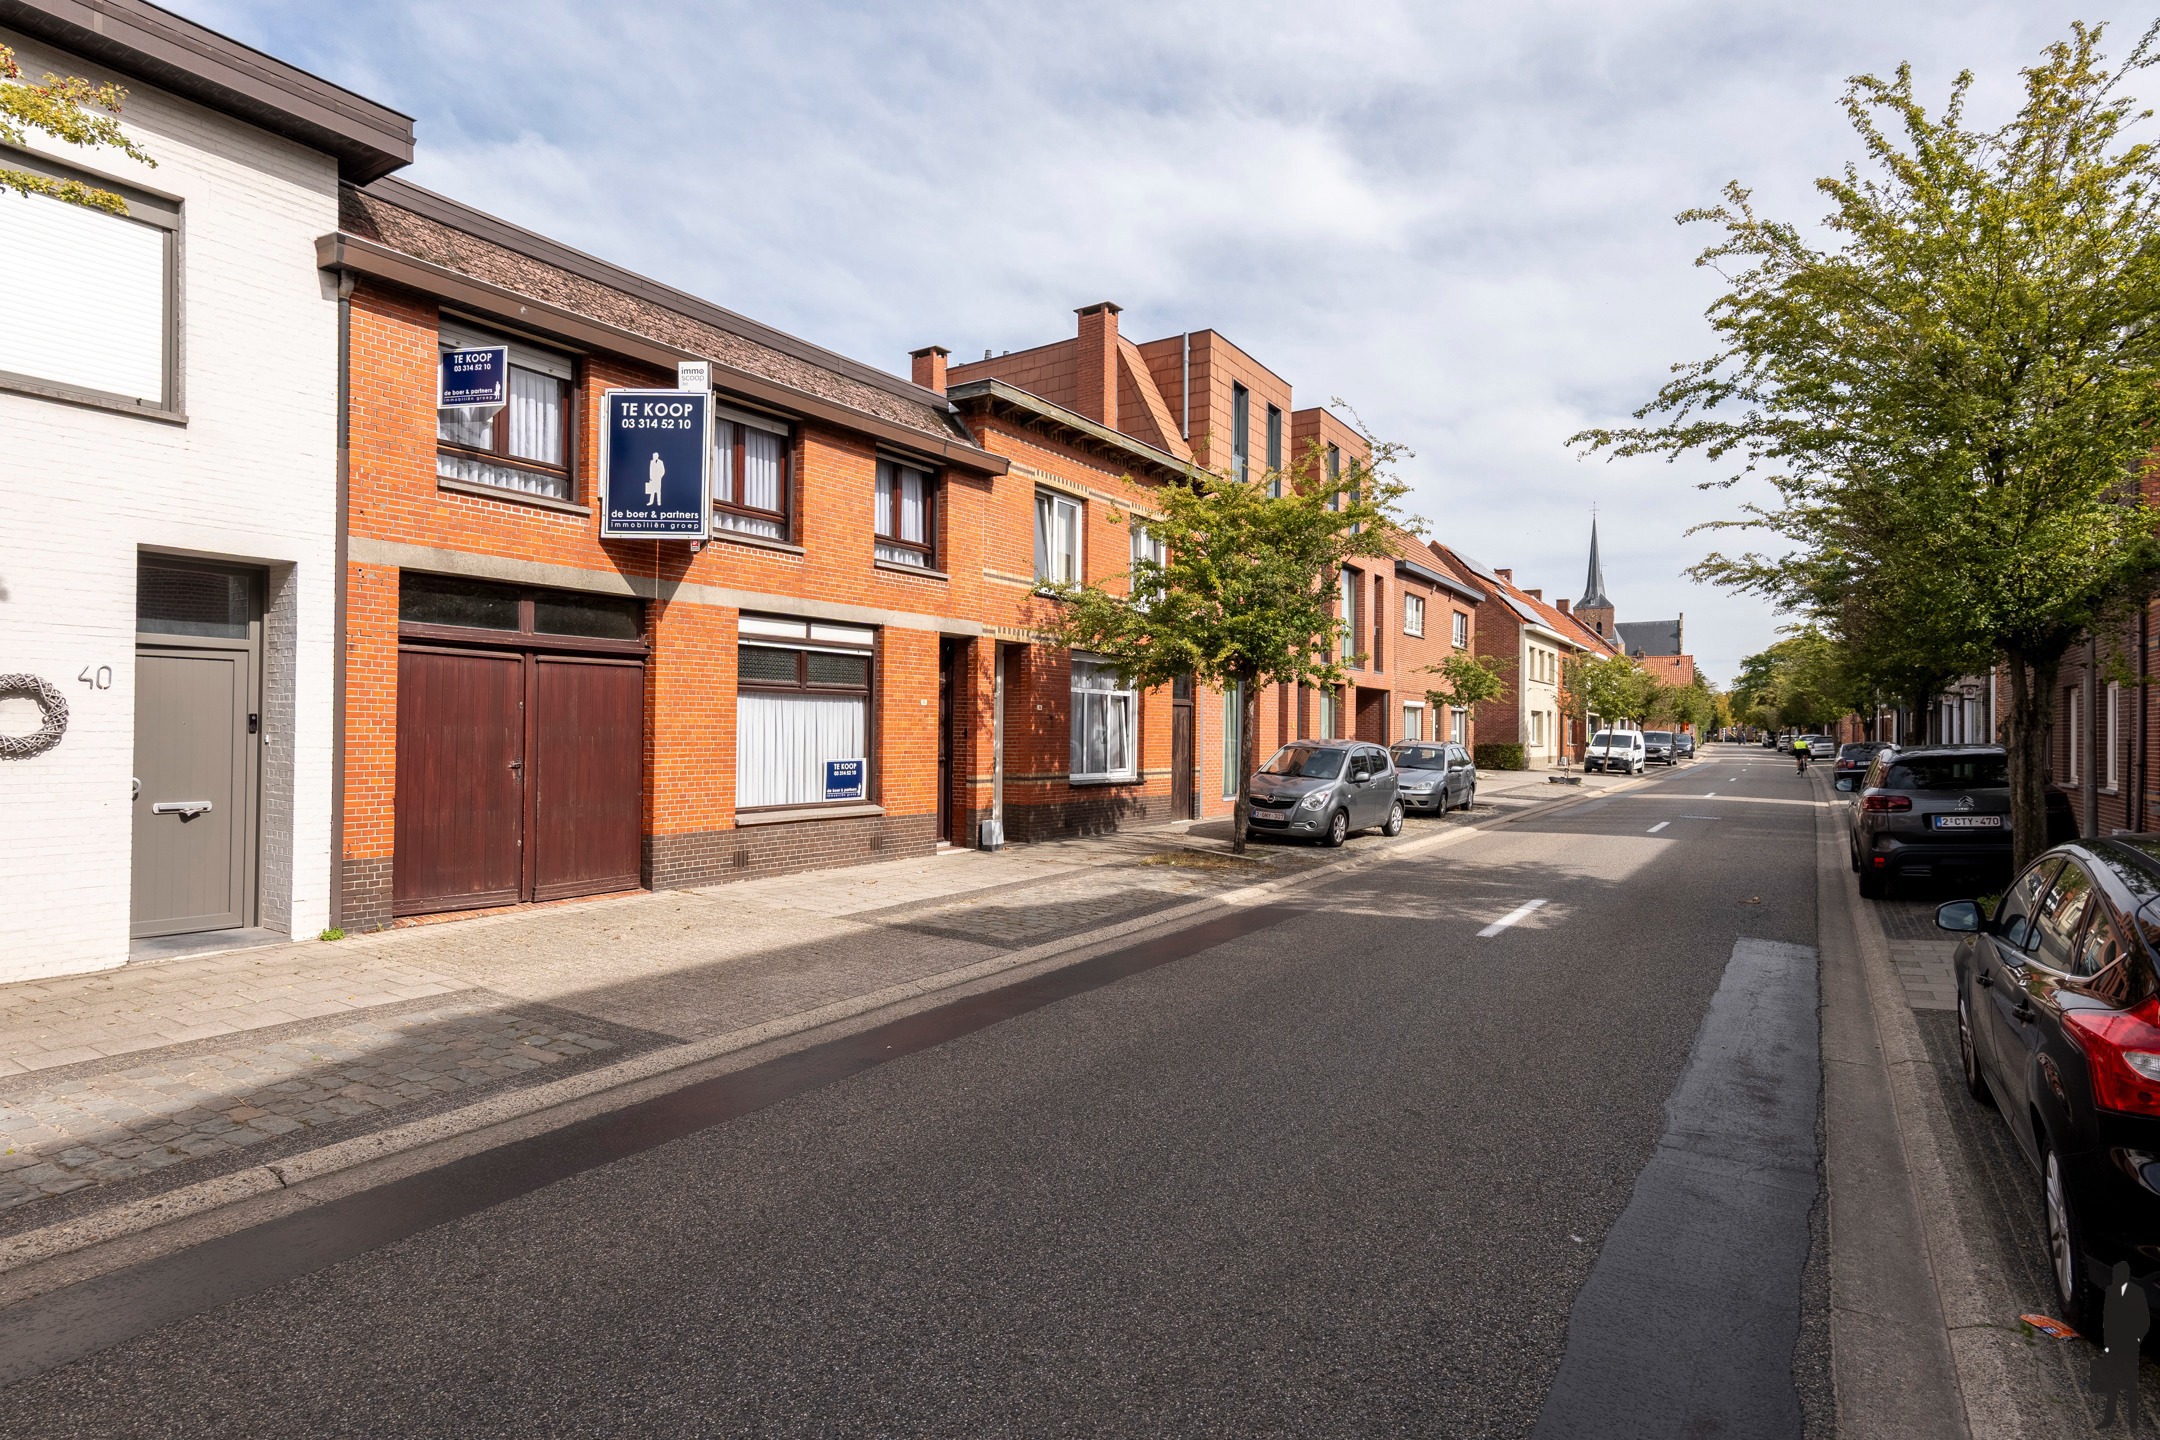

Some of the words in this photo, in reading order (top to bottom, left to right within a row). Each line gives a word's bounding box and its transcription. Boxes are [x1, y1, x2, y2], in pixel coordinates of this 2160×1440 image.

[454, 354, 464, 364] TE
[466, 353, 492, 363] KOOP
[462, 364, 473, 372] 314
[681, 366, 704, 375] immo
[621, 402, 638, 417] TE
[644, 402, 693, 417] KOOP
[621, 418, 636, 429] 03
[638, 418, 658, 429] 314
[661, 418, 675, 429] 52
[678, 419, 691, 430] 10
[611, 510, 623, 518] de
[626, 510, 648, 518] boer
[660, 511, 699, 520] partners
[77, 664, 112, 690] 40
